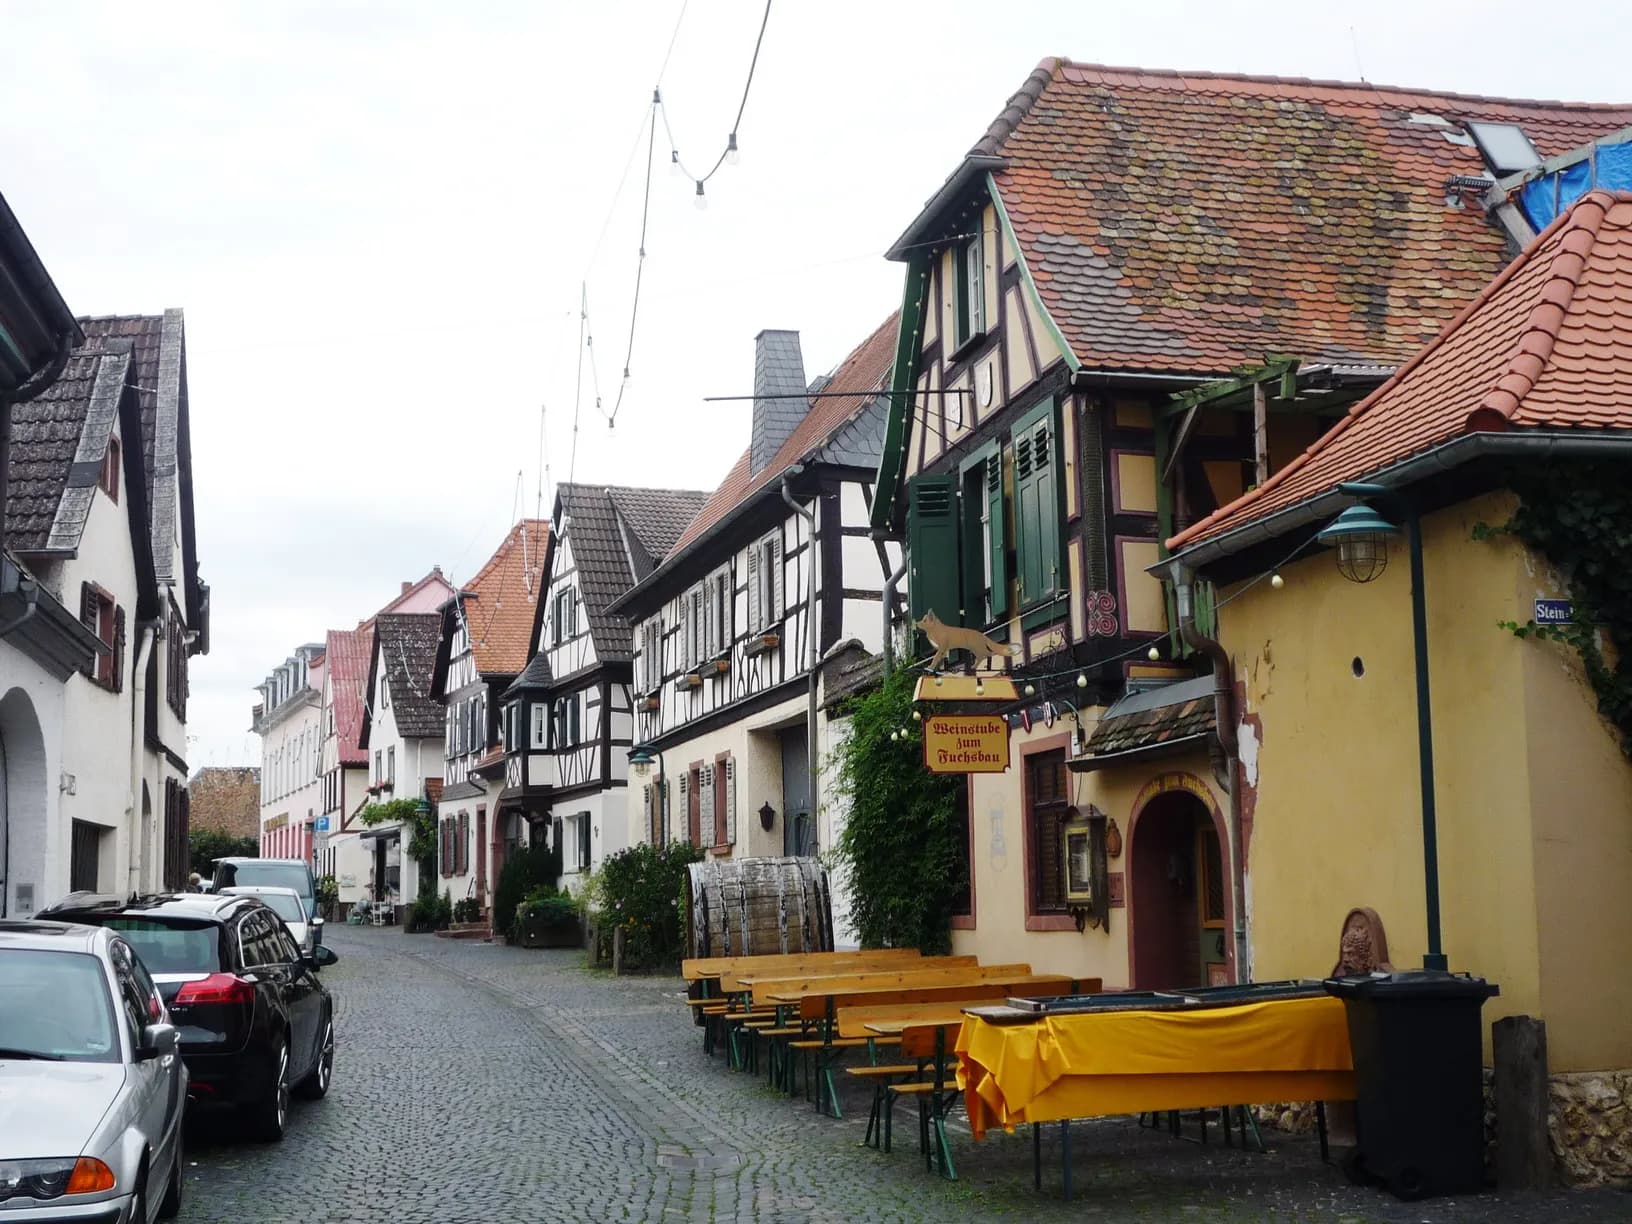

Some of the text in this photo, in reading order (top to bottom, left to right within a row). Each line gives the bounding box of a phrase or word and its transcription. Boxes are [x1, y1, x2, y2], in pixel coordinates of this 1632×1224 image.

[933, 722, 1000, 735] Weinstube
[956, 738, 981, 749] zum
[937, 750, 1000, 764] Fuchsbau
[317, 818, 327, 829] P
